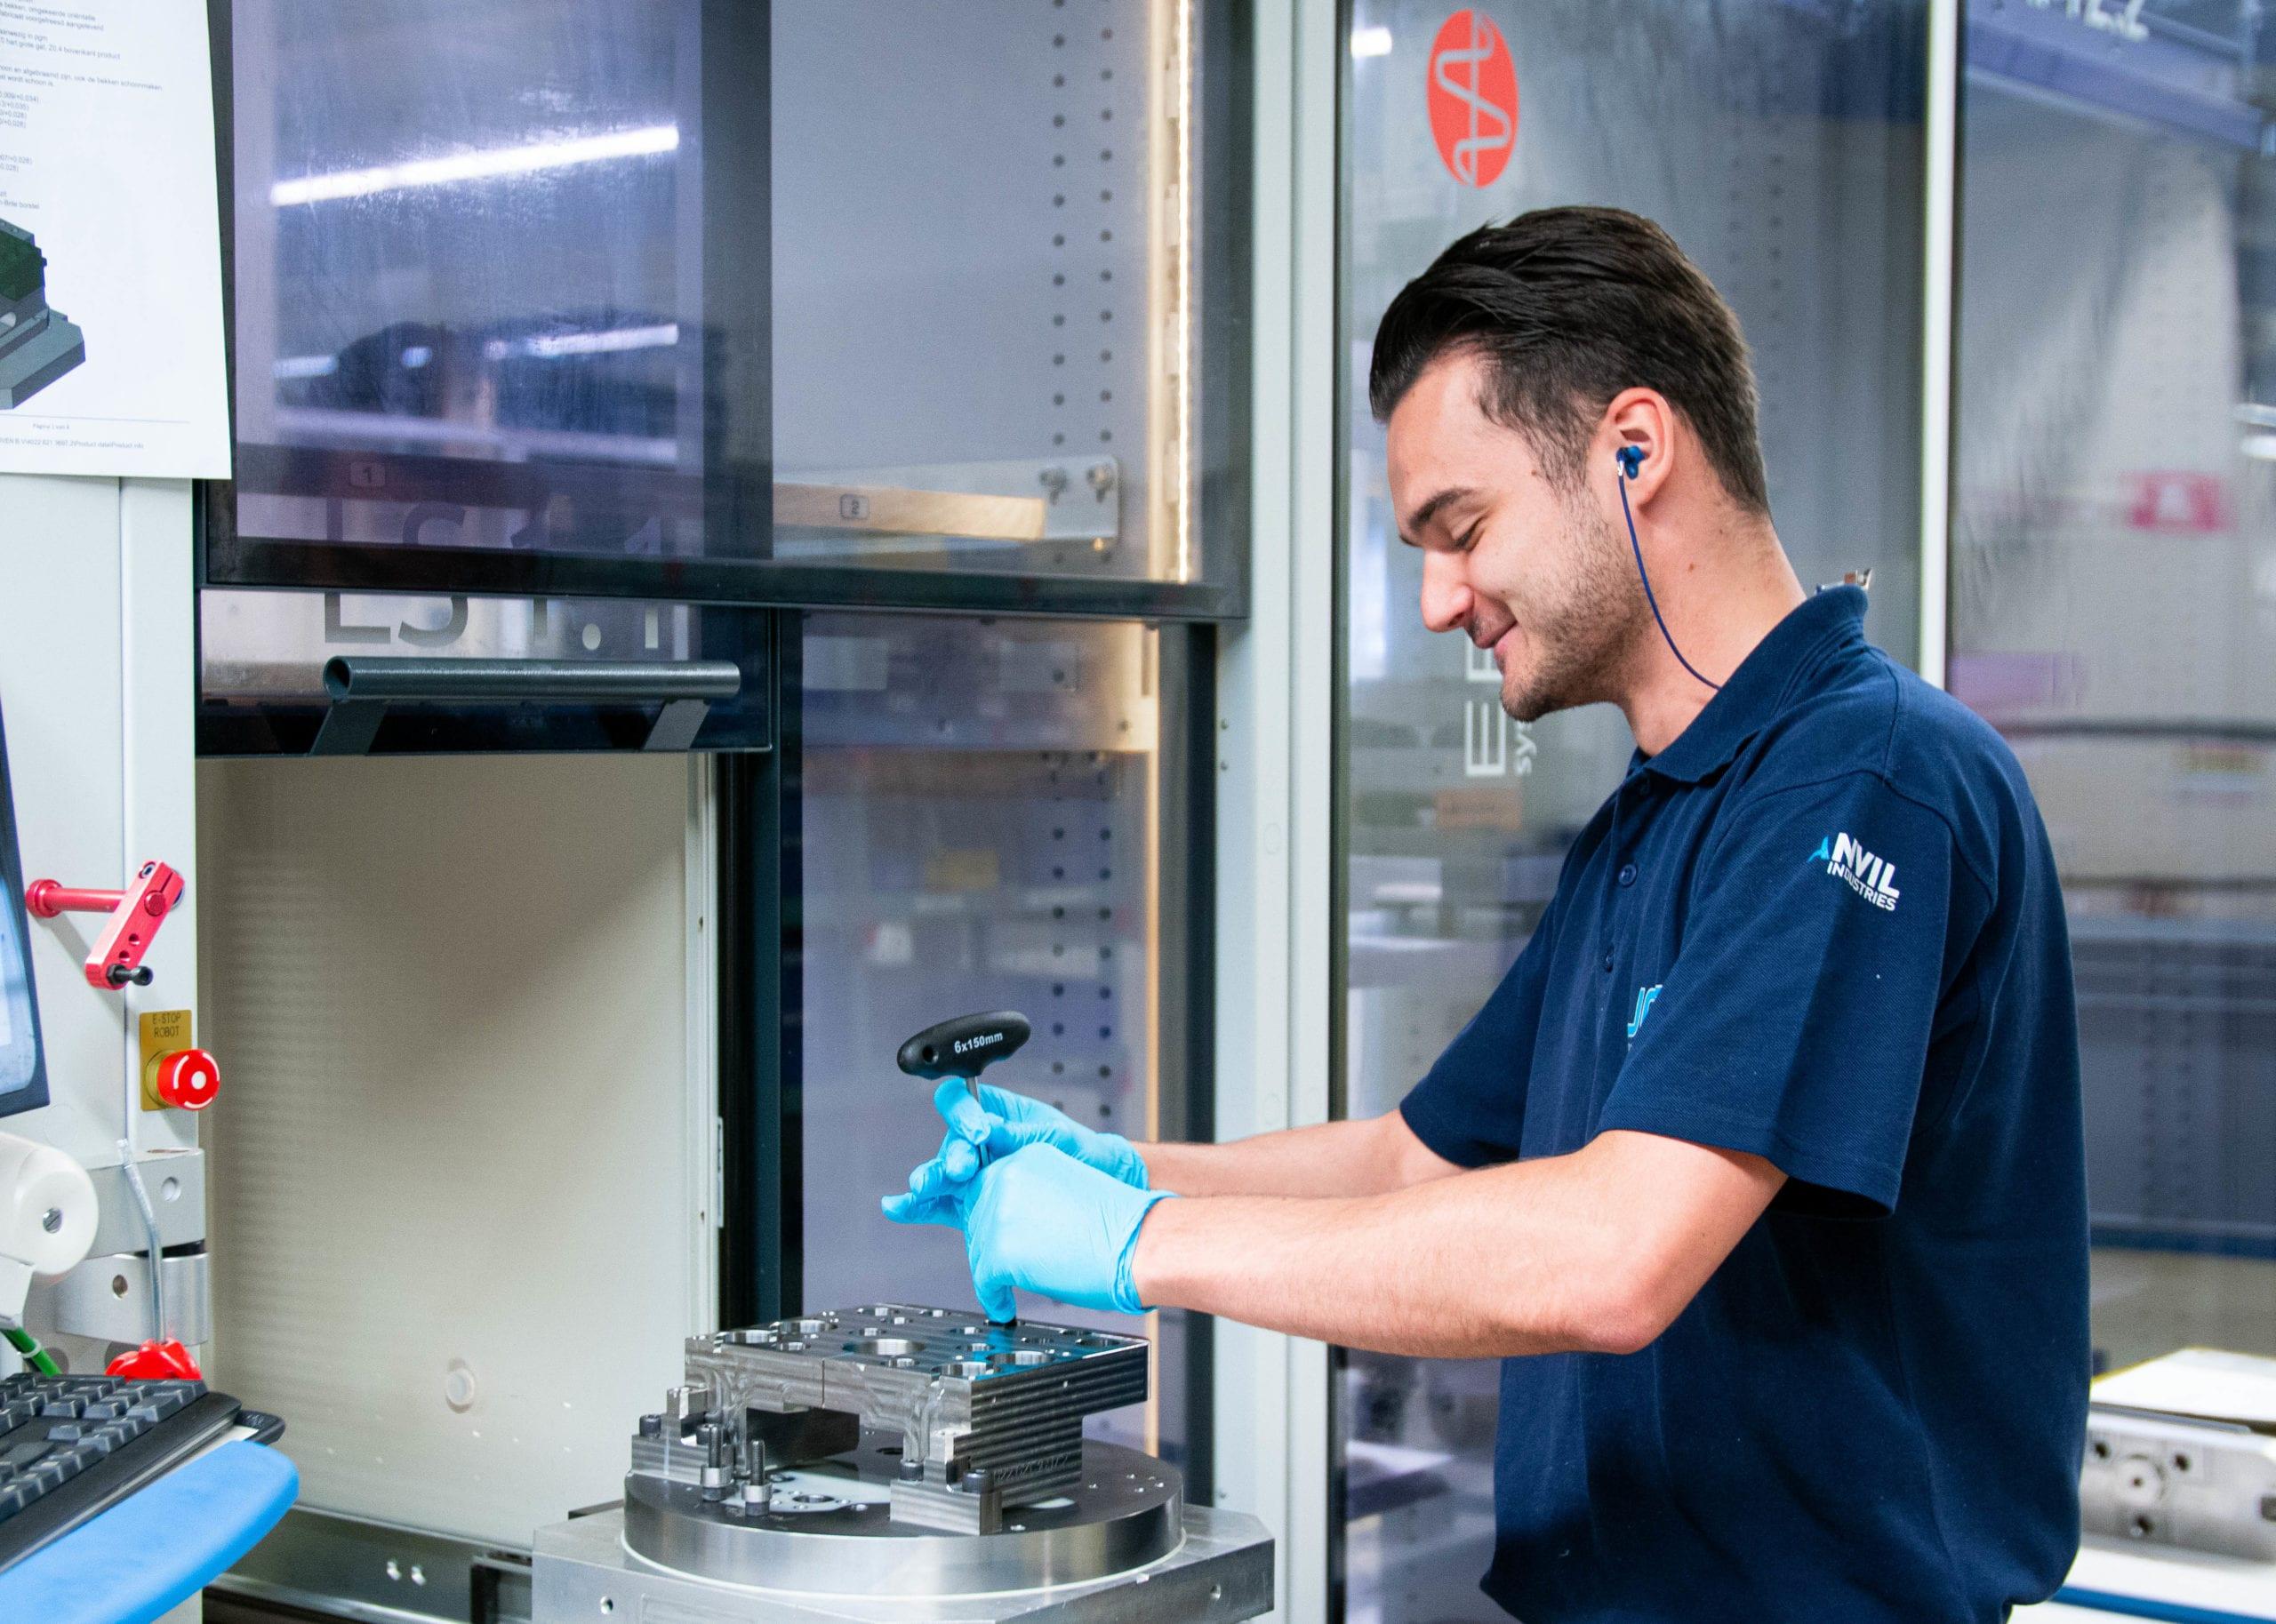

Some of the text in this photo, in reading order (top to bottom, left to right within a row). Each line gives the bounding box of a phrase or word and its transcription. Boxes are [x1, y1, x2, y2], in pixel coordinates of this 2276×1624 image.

[1826, 861, 1897, 911] INDUSTRIES
[152, 1012, 181, 1025] E-STOP
[154, 1026, 180, 1038] ROBOT
[954, 1032, 1004, 1054] 6x150mm
